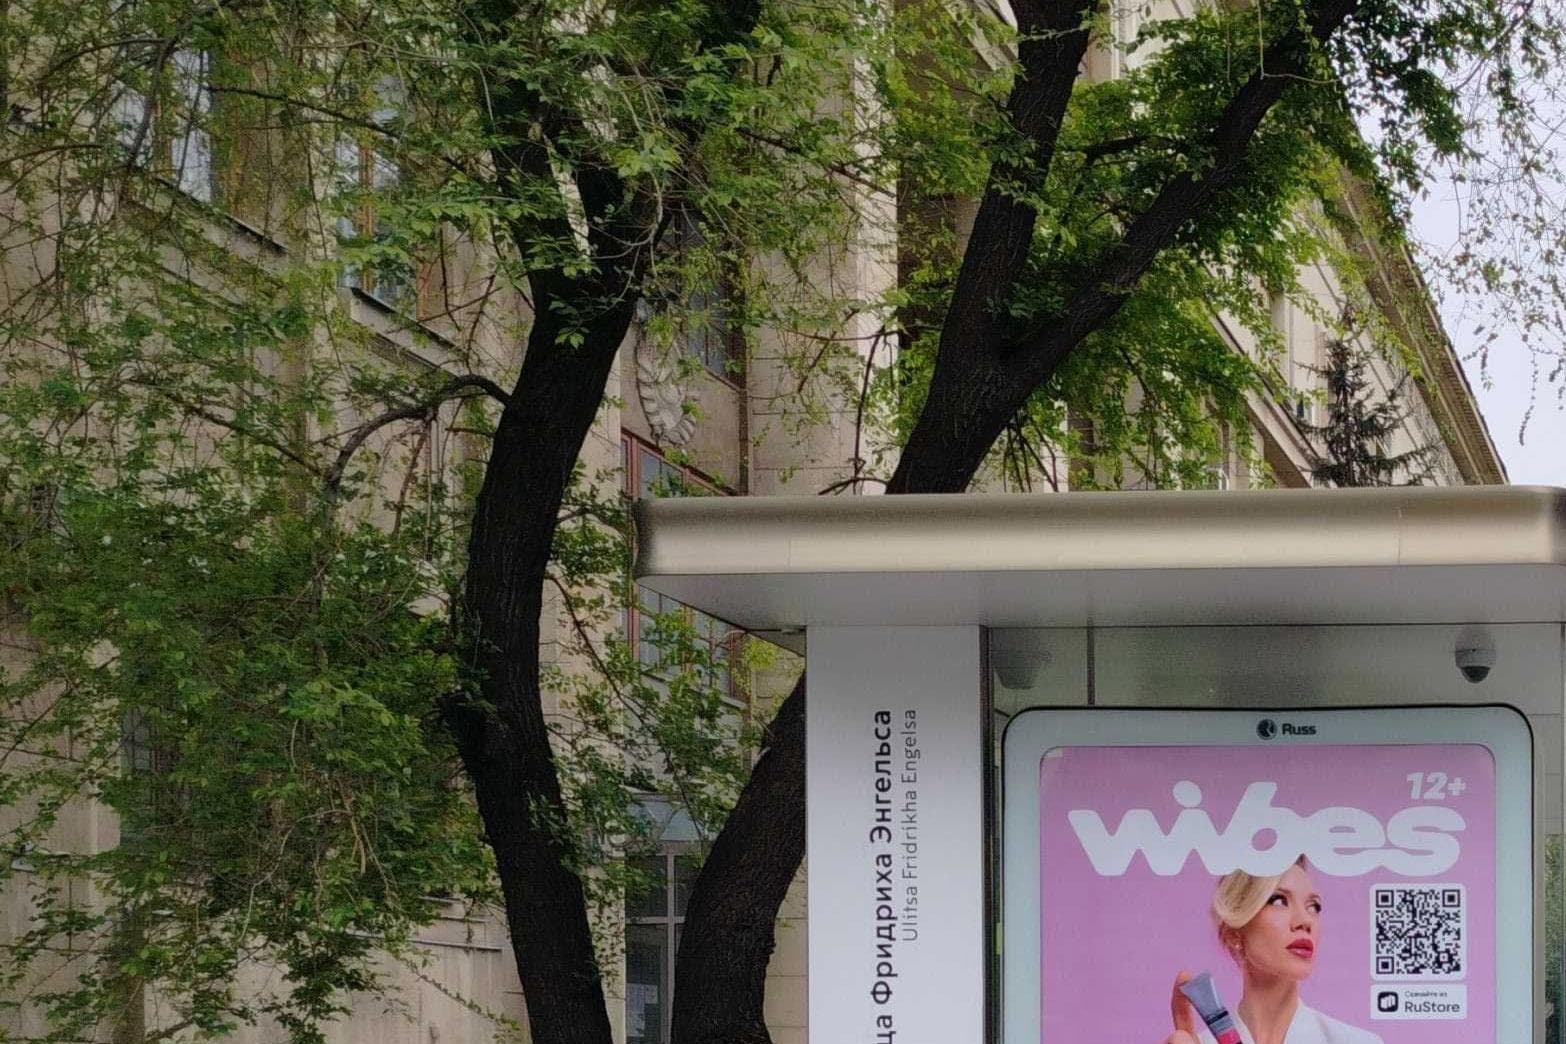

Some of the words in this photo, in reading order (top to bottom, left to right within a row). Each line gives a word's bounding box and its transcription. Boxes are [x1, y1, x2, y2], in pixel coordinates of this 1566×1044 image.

[900, 709, 920, 783] Engelsa
[1282, 723, 1317, 735] Russ
[870, 710, 892, 844] Энгельса
[1406, 772, 1467, 800] 12+
[901, 790, 918, 879] Fridrikha
[1067, 780, 1467, 877] wibes
[870, 854, 898, 1005] Фридриха
[902, 886, 918, 942] Ulitsa
[1404, 1002, 1460, 1013] RuStore
